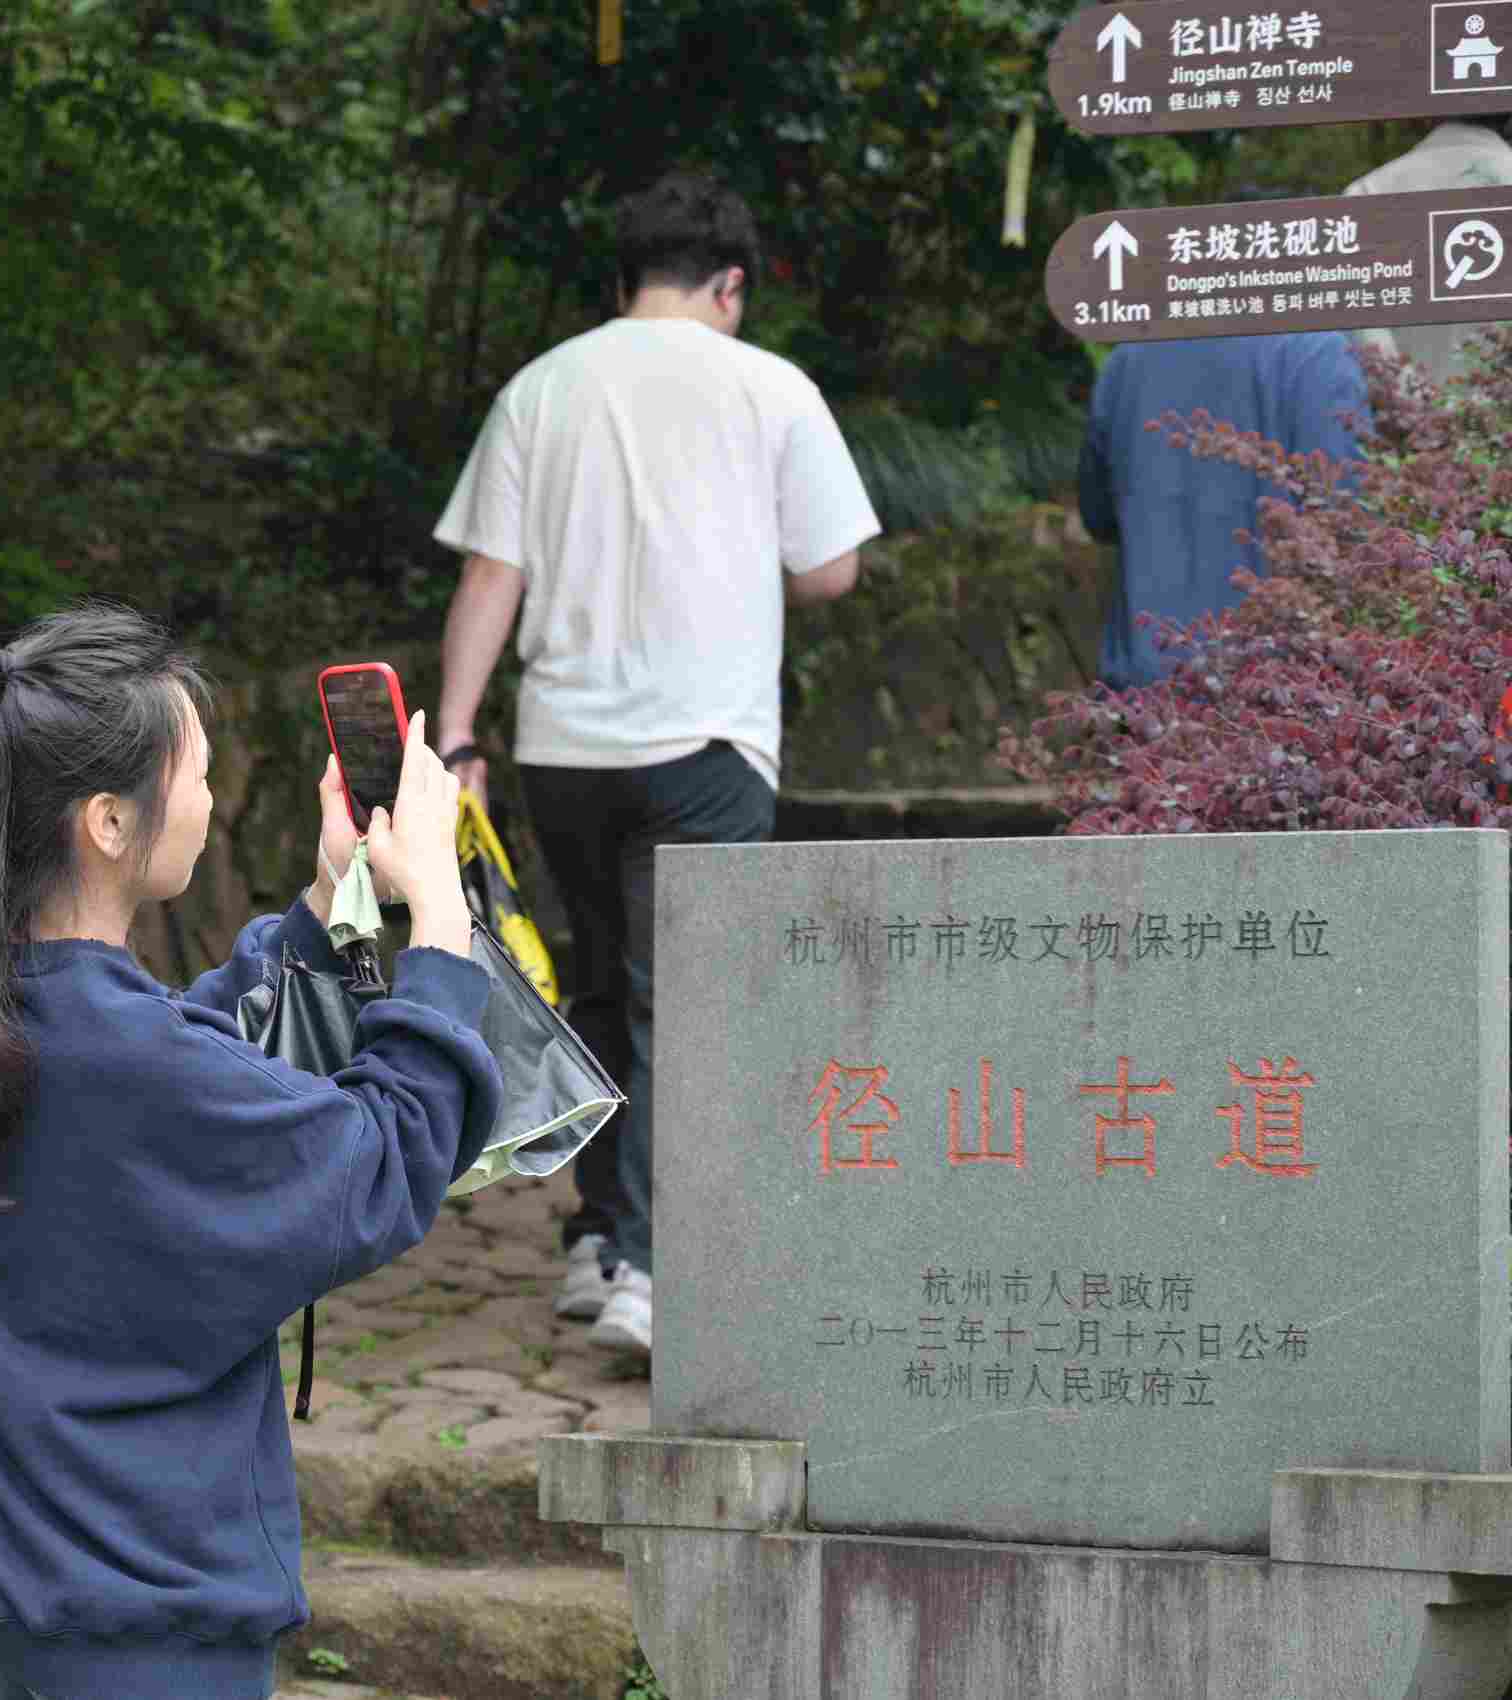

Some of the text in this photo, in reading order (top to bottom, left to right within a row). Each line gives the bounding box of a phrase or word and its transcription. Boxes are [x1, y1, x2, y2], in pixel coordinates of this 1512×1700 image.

[1168, 11, 1322, 58] 径山禅寺
[1168, 56, 1353, 86] Jingshan Zen Temple
[1078, 93, 1152, 117] 1.9km
[1297, 81, 1333, 103] 선사
[1168, 214, 1362, 265] 东坡洗砚池
[1167, 259, 1413, 294] Dongpo's Inkstone Washing Pond
[1074, 300, 1152, 325] 3.1km
[1272, 293, 1304, 313] 동파
[1344, 288, 1376, 308] 씻는
[1380, 286, 1413, 306] 연못
[785, 910, 1331, 966] 杭州市市级文物保护单位
[806, 1056, 1321, 1178] 径山古道
[922, 1267, 1195, 1312] 杭州市人民政府
[903, 1361, 1215, 1407] 杭州市人民政府立
